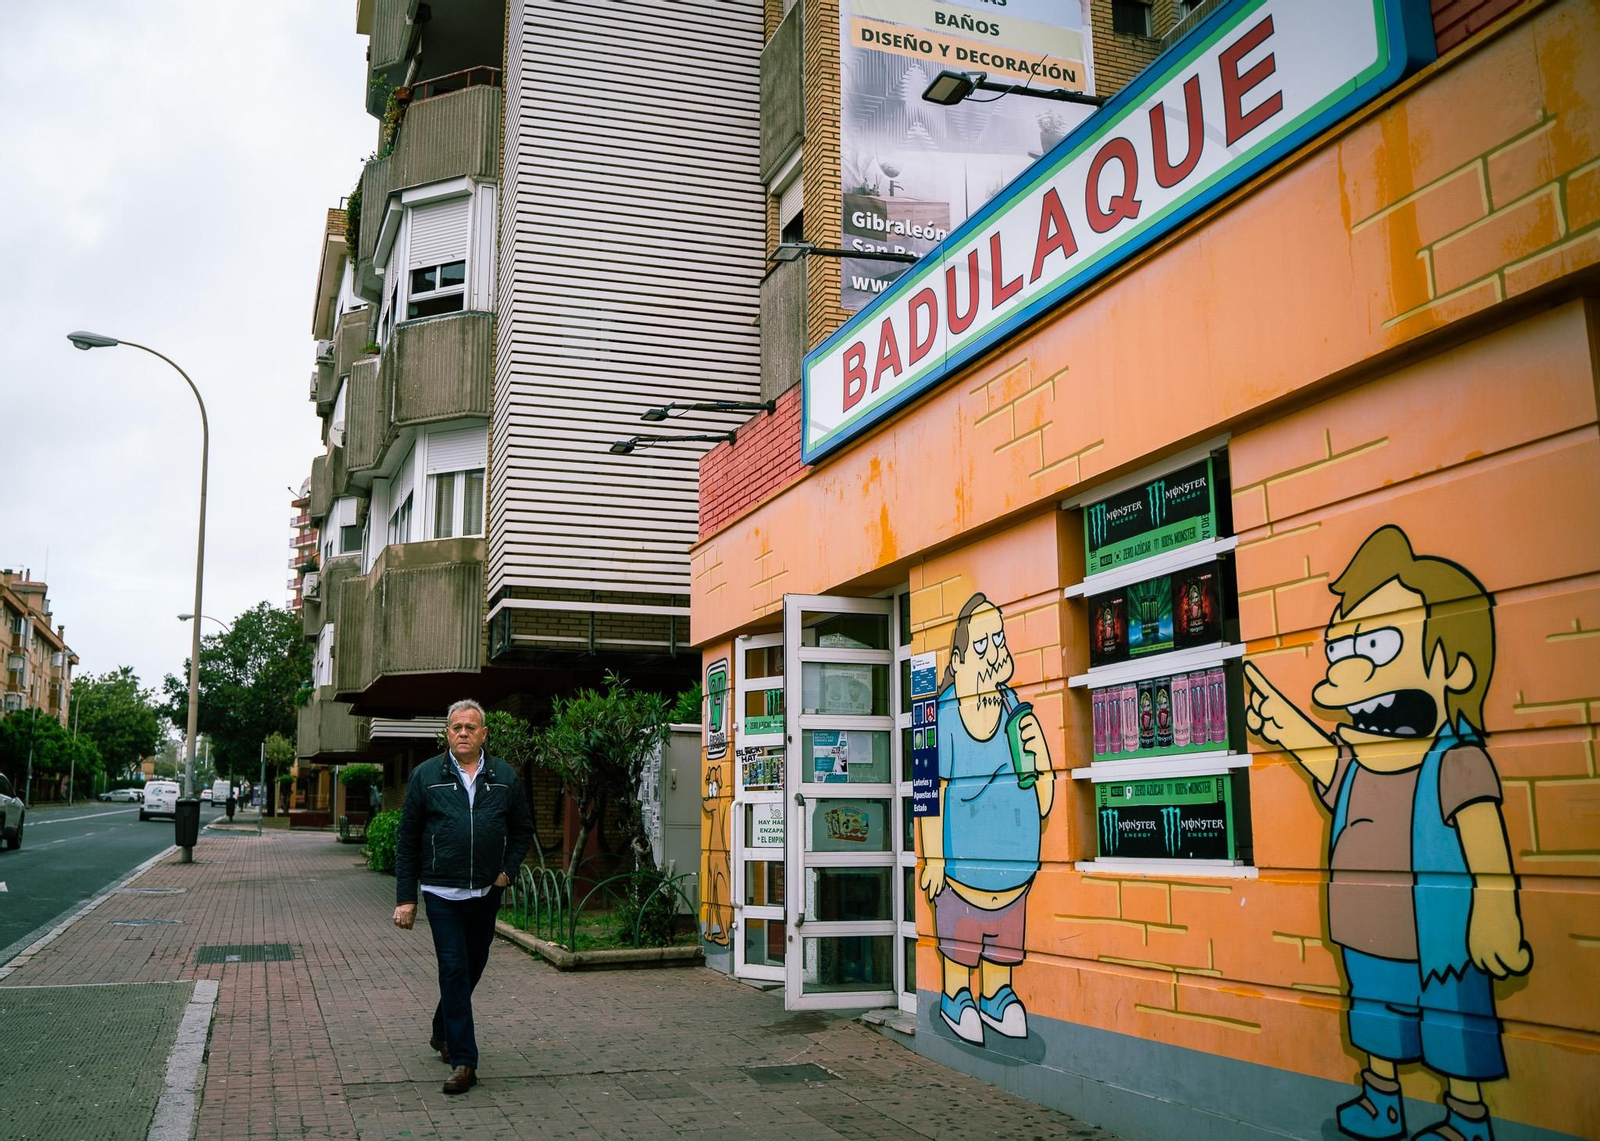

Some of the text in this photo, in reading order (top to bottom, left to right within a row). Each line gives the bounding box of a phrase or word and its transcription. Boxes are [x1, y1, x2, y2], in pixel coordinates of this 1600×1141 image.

[934, 11, 1000, 36] BAÑOS
[860, 27, 1076, 83] DISEÑO Y DECORACIÓN
[842, 14, 1284, 414] BADULAQUE
[851, 211, 948, 241] Gibraleón
[851, 276, 893, 293] ww
[1171, 491, 1201, 505] ENERGY
[1111, 514, 1138, 527] ENERGY
[1122, 548, 1134, 560] ZERO
[1161, 535, 1174, 548] 100%
[1174, 526, 1196, 546] MONSTER
[736, 746, 761, 757] BLACK
[741, 755, 757, 763] HAT
[913, 778, 928, 787] Loterías
[1134, 785, 1146, 796] ZERO
[1146, 782, 1164, 796] AZÚCAR
[1175, 783, 1188, 795] 100%
[1188, 781, 1212, 794] MONSTER
[913, 791, 931, 801] Apuestas
[913, 804, 927, 812] Estado
[1118, 819, 1157, 831] MONSTER
[1180, 818, 1225, 831] MONSTER
